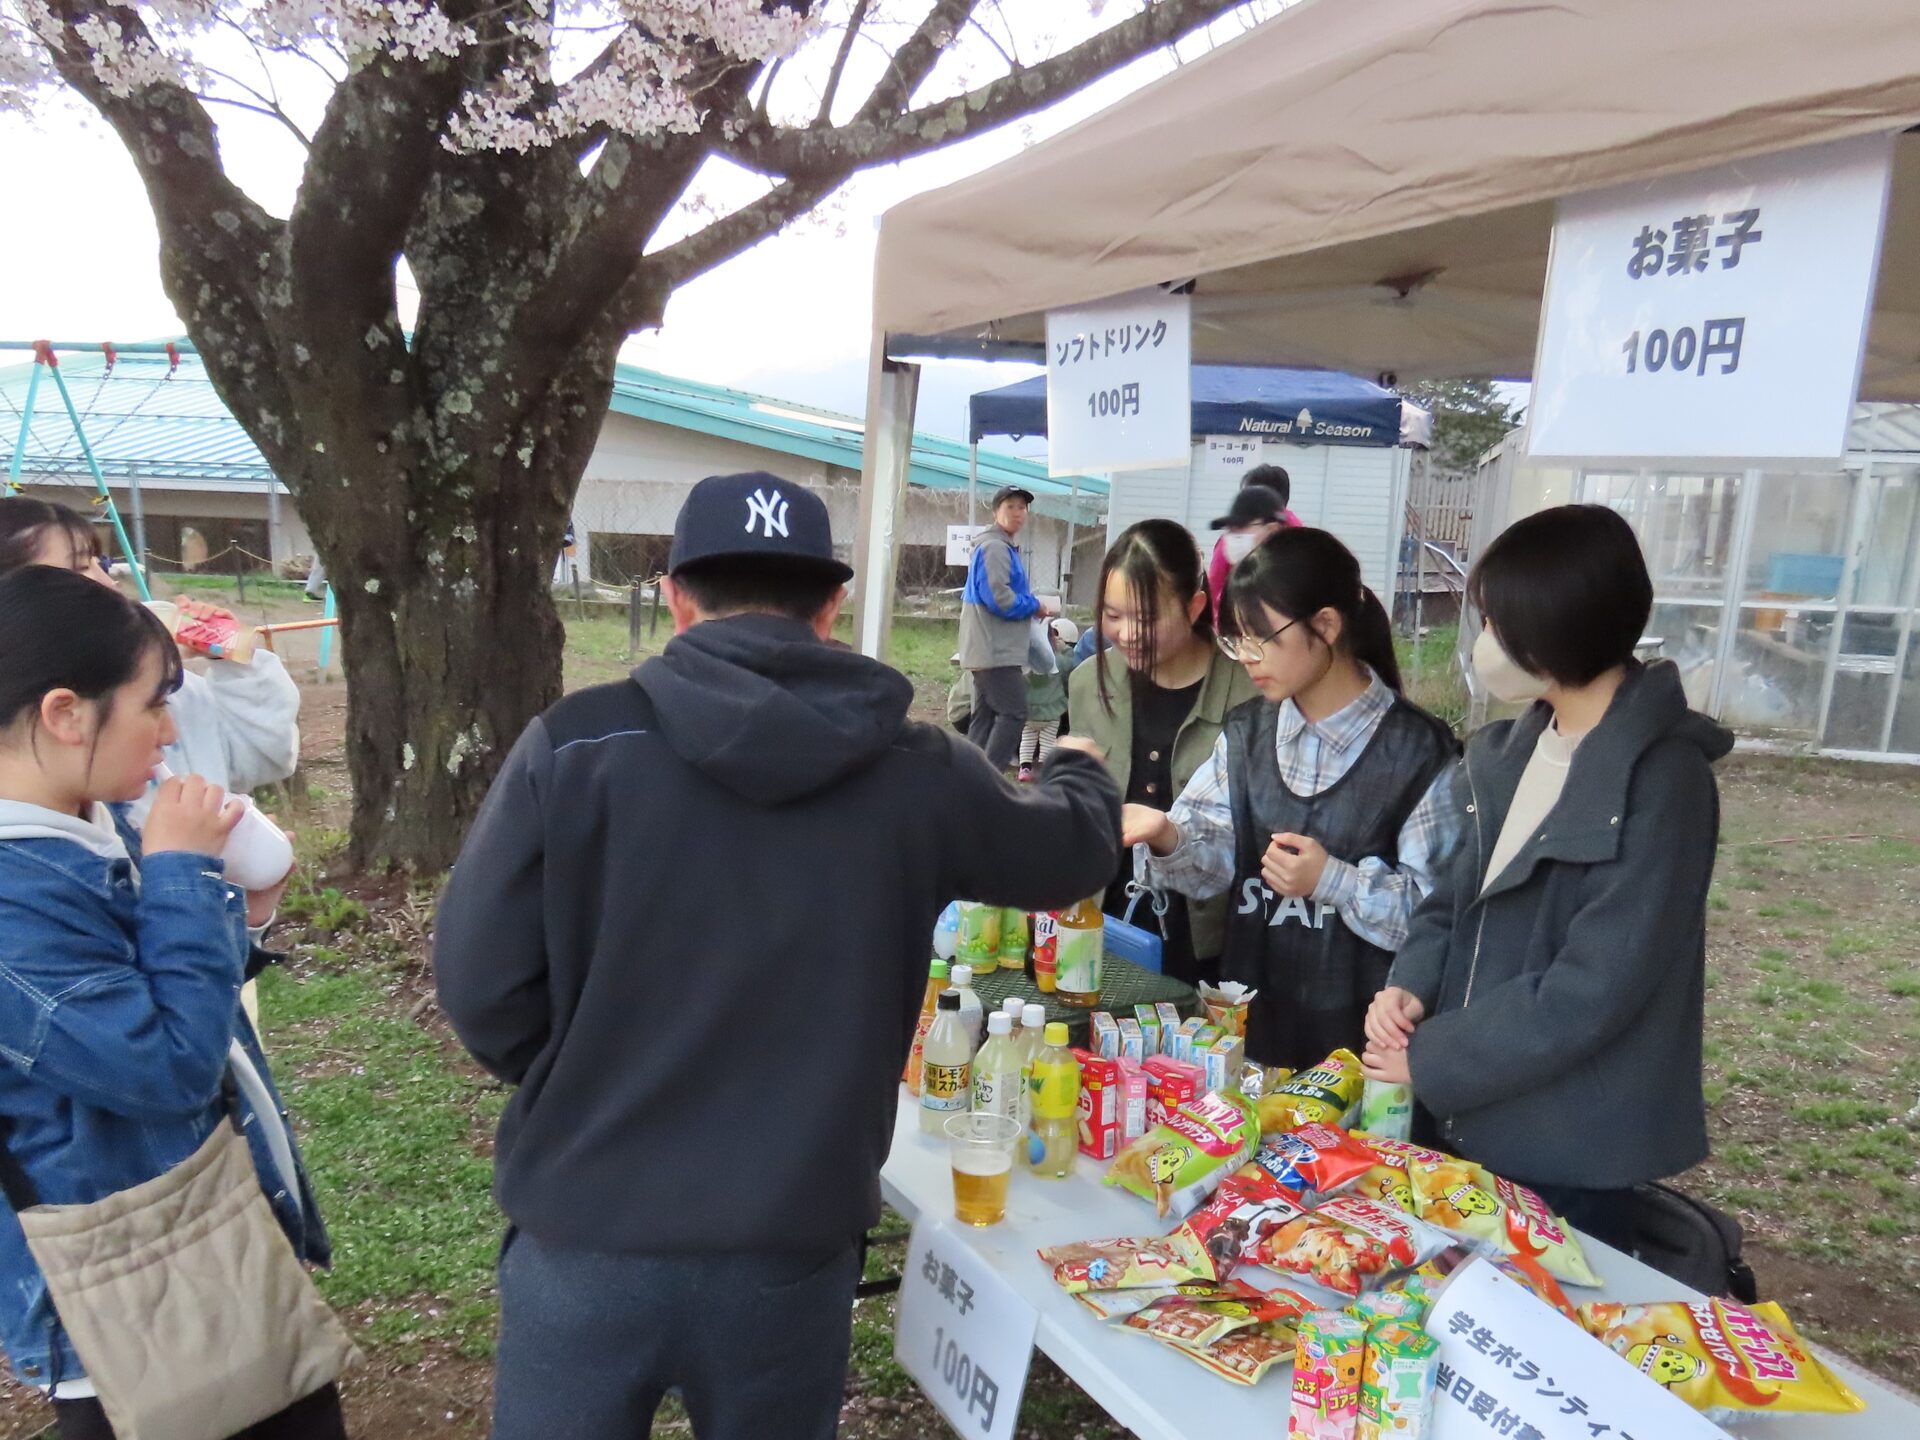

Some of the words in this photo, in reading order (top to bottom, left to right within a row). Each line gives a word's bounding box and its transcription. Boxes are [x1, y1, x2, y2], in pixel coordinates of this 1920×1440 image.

[1626, 208, 1763, 280] お菓子
[1056, 319, 1168, 367] ソフトドリンク
[1621, 317, 1746, 377] 100円
[1088, 382, 1140, 418] 100円
[1239, 418, 1293, 434] Natural
[1314, 422, 1373, 438] Season
[1222, 456, 1244, 465] 100円
[744, 488, 790, 539] NY
[1237, 877, 1337, 929] STAF
[921, 1249, 975, 1317] お菓子
[932, 1326, 999, 1434] 100円
[1329, 1391, 1359, 1409] コアラ
